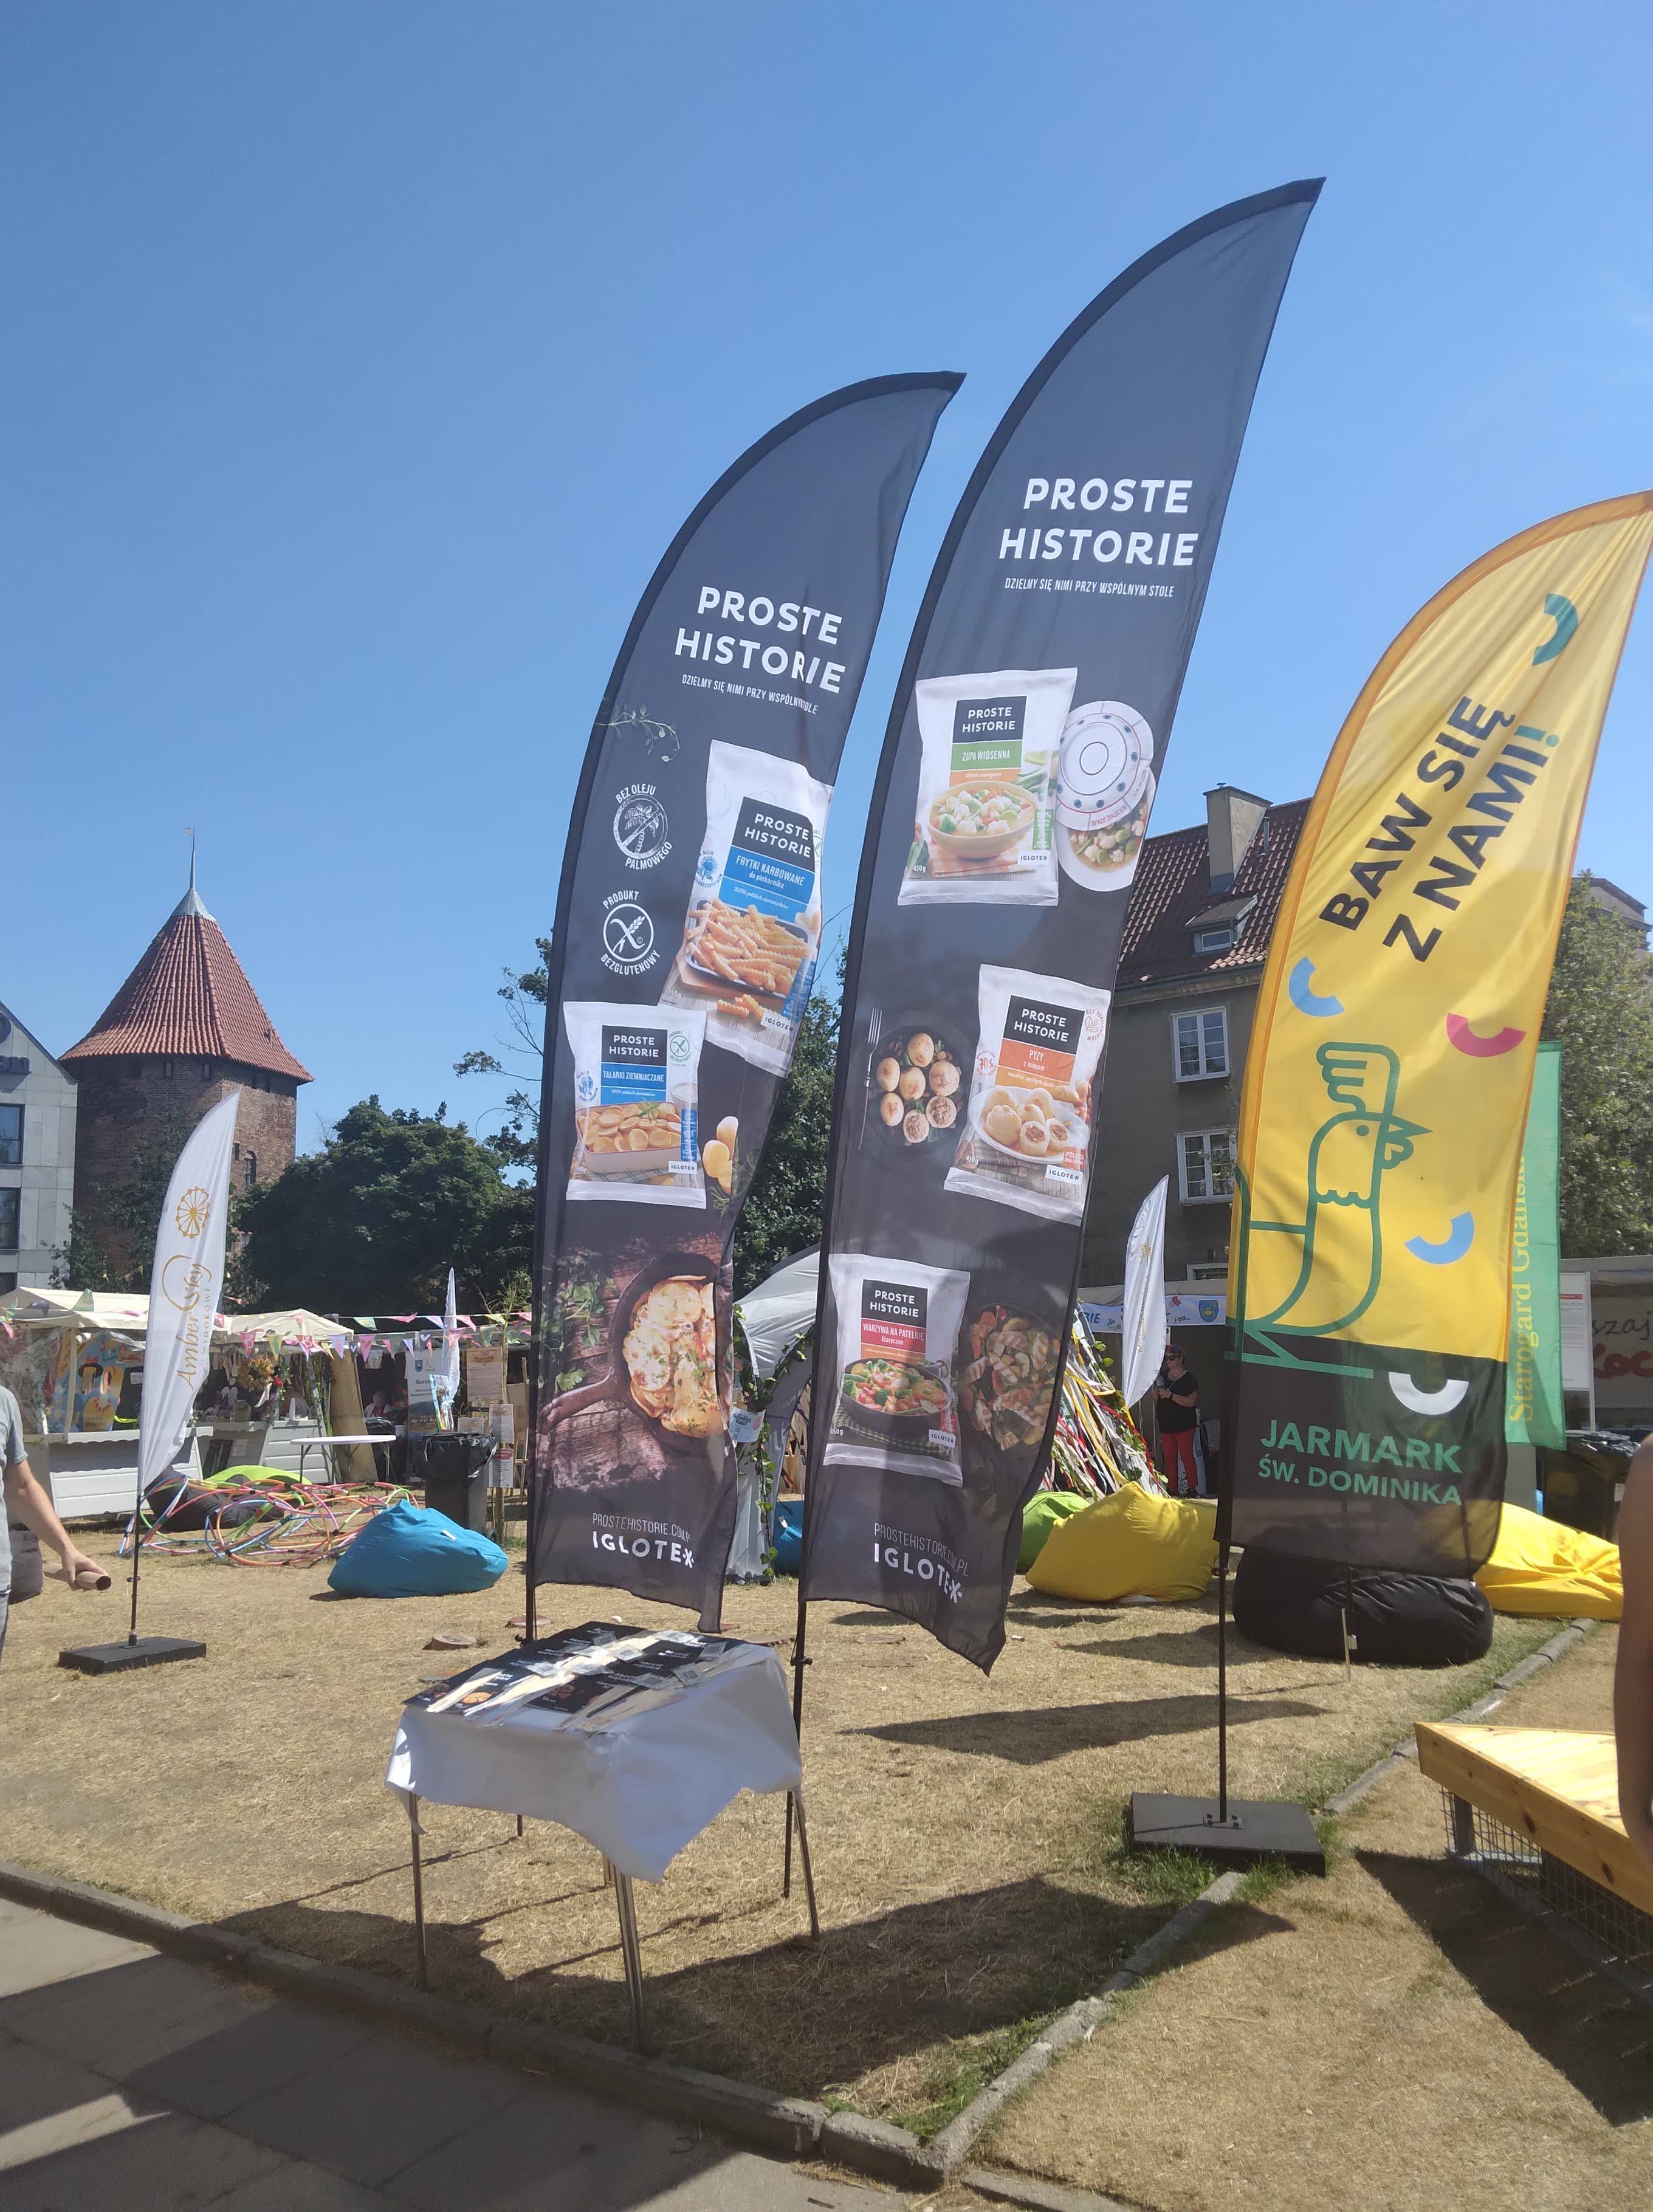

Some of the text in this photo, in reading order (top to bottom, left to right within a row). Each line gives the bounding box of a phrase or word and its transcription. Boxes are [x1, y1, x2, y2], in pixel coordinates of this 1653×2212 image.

[1023, 478, 1193, 513] PROSTE
[998, 527, 1199, 566] HISTORIE
[1005, 577, 1175, 598] DZIELMY SIĘ NIMI PRZY WSPÓLNYM STOLE
[698, 586, 842, 645] PROSTE
[675, 628, 846, 693] HISTORIE
[682, 674, 712, 689] DZIELMY
[713, 680, 725, 693] SIĘ
[727, 683, 744, 696] NIMI
[746, 687, 767, 699] PRZY
[967, 707, 1012, 719] PROSTE
[962, 720, 1016, 733] HISTORIE
[962, 749, 1011, 761] ZUPA WIOSENNA
[615, 783, 656, 803] BEZ OLEJU
[1091, 805, 1128, 826] SPACE SAUCER
[1318, 695, 1516, 931] BAW SIĘ
[754, 813, 809, 840] PROSTE
[744, 826, 811, 857] HISTORIE
[1382, 724, 1560, 963] Z NAMI!
[625, 841, 672, 870] PALMOWEGO
[735, 855, 805, 886] FRYTKI KARBOWANE
[913, 865, 926, 873] 450g
[756, 874, 785, 889] piekarnika
[603, 890, 639, 909] PRODUKT
[600, 949, 661, 975] BEZGLUTENOWY
[1021, 1008, 1067, 1028] PROSTE
[613, 1034, 655, 1046] PROSTE
[1014, 1021, 1070, 1043] HISTORIE
[609, 1046, 659, 1057] HISTORIE
[1029, 1049, 1045, 1062] PYZY
[603, 1070, 665, 1082] TALARKI ZIEMNIACZANE
[875, 1290, 915, 1304] PROSTE
[870, 1302, 919, 1317] HISTORIE
[202, 1288, 211, 1355] WIDOKOWE
[863, 1322, 924, 1342] WARZYWA NA PATELNIĘ
[176, 1311, 199, 1391] Amber
[1508, 1282, 1540, 1421] Starogard
[1260, 1419, 1463, 1474] JARMARK
[1258, 1453, 1463, 1506] ŚW. DOMINIKA
